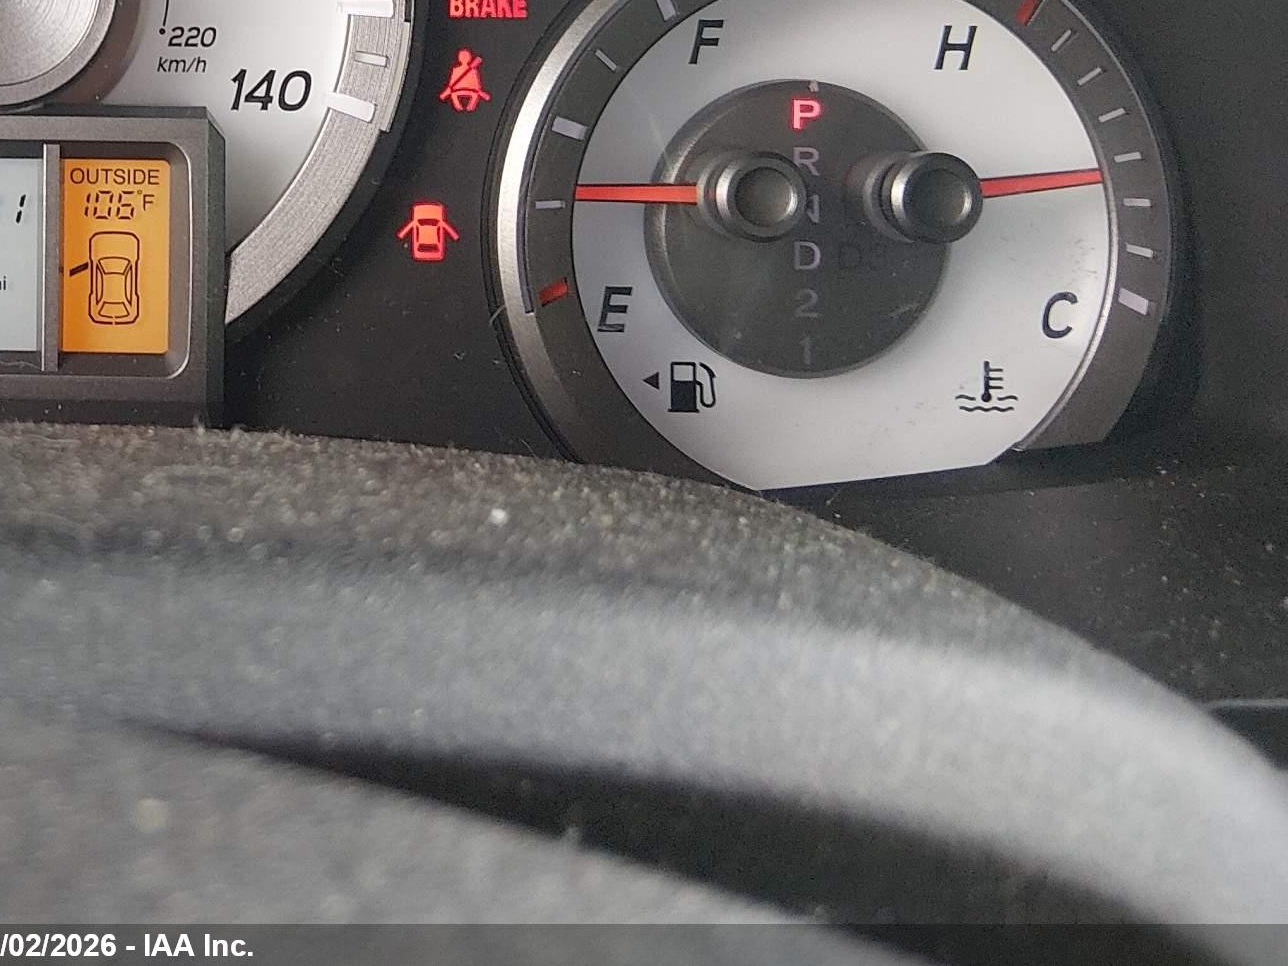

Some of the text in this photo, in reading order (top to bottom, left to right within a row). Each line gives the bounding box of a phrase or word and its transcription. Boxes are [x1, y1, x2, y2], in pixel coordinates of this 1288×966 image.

[168, 26, 217, 47] 220
[688, 19, 724, 65] F
[934, 25, 977, 71] H
[157, 56, 206, 73] km/h
[231, 69, 312, 112] 140
[791, 97, 822, 130] P
[69, 167, 160, 186] OUTSIDE
[792, 146, 820, 176] R
[793, 241, 821, 271] D
[597, 285, 633, 333] E
[794, 288, 820, 319] 2
[1041, 291, 1078, 339] C
